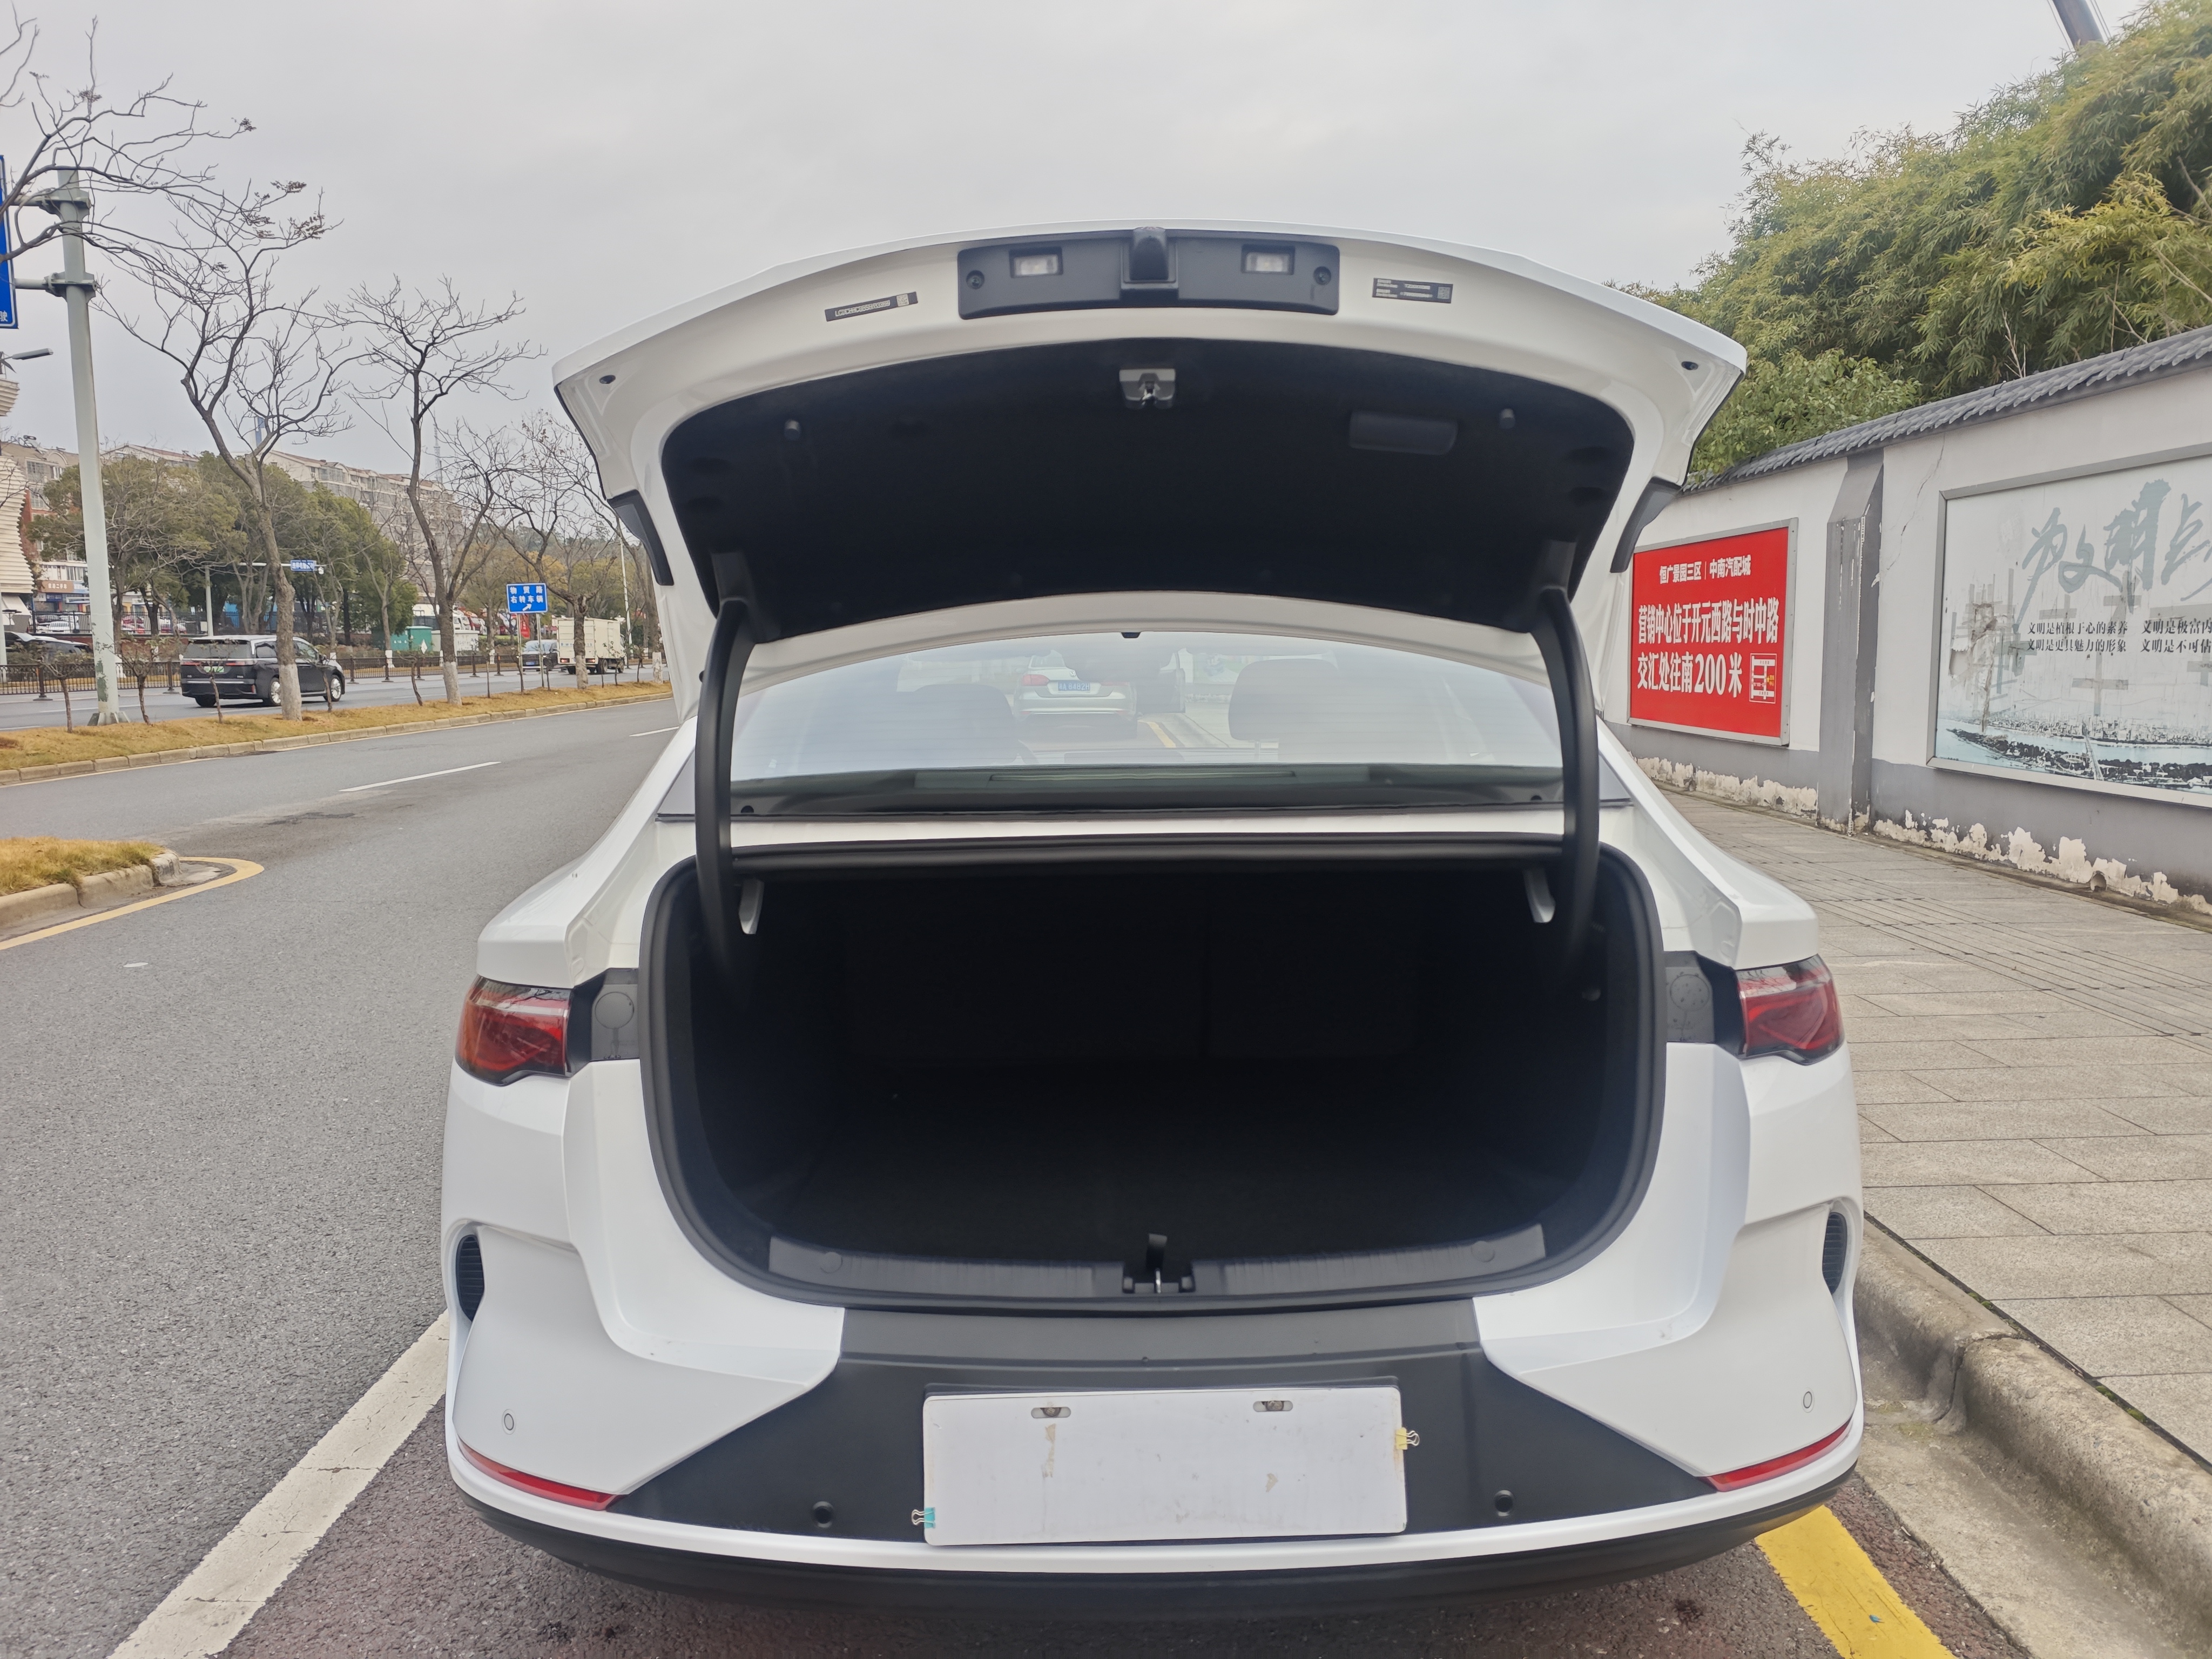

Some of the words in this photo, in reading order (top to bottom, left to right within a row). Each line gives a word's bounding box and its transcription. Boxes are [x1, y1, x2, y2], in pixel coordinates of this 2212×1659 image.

[1659, 561, 1702, 584] 恒广景园三区
[1709, 554, 1751, 579] 中南汽配城
[510, 595, 543, 604] 右转车辆
[1638, 597, 1779, 644] 营销中心位于开元西路与时中路
[2027, 621, 2128, 635] 文明是植根于心的素养
[2026, 638, 2127, 652] 文明是更具魅力的形象
[1637, 651, 1743, 698] 交汇处往南200米
